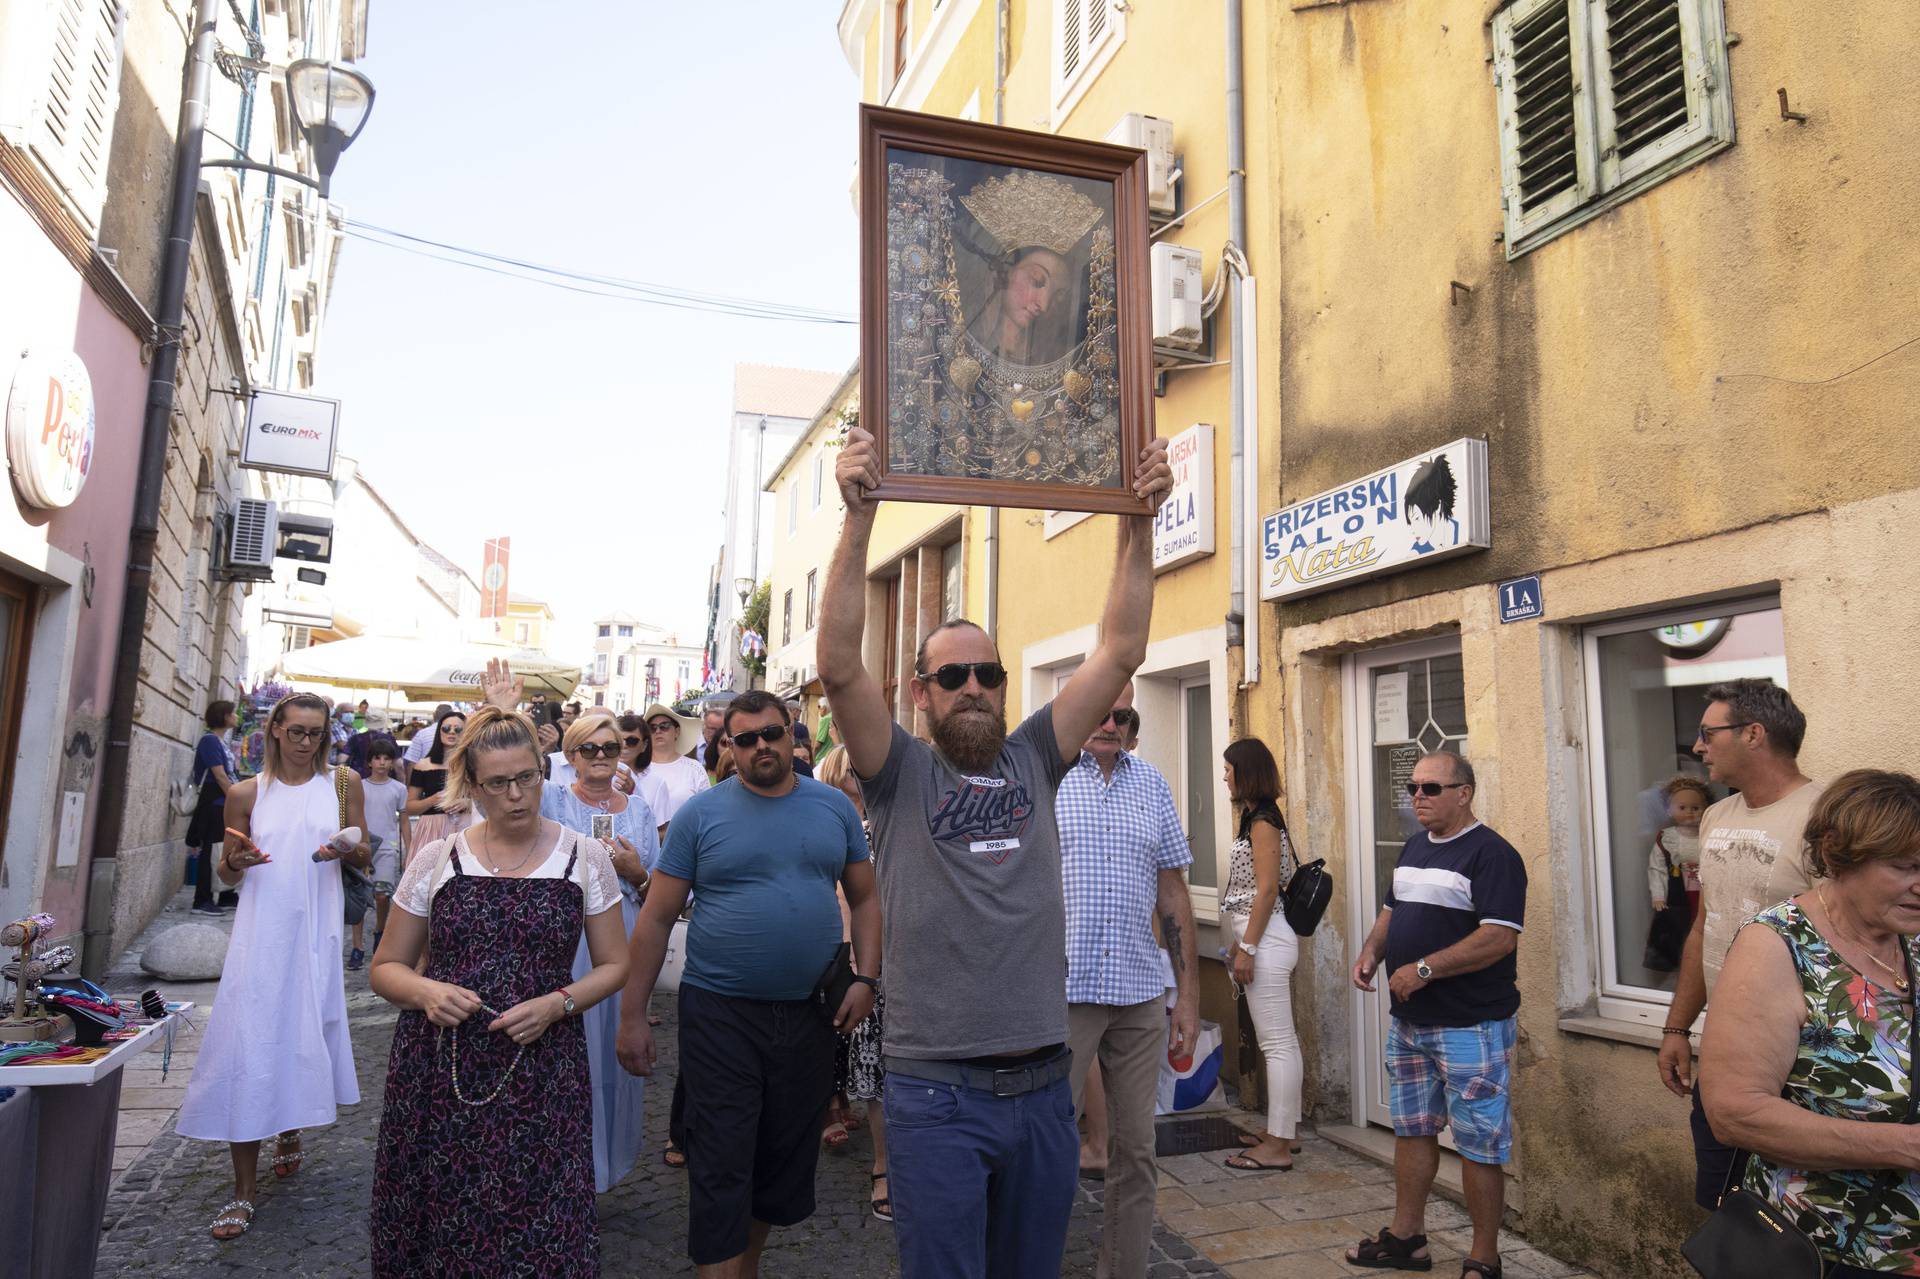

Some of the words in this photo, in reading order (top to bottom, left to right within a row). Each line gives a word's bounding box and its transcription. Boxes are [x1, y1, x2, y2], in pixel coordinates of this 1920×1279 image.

[1169, 434, 1198, 466] ARSKA
[1154, 491, 1196, 537] PELA
[1264, 472, 1397, 546] FRIZERSKI
[1264, 501, 1398, 561] SALON
[1270, 535, 1388, 588] Nata
[968, 777, 1003, 786] OMMY
[985, 841, 1007, 850] 1985
